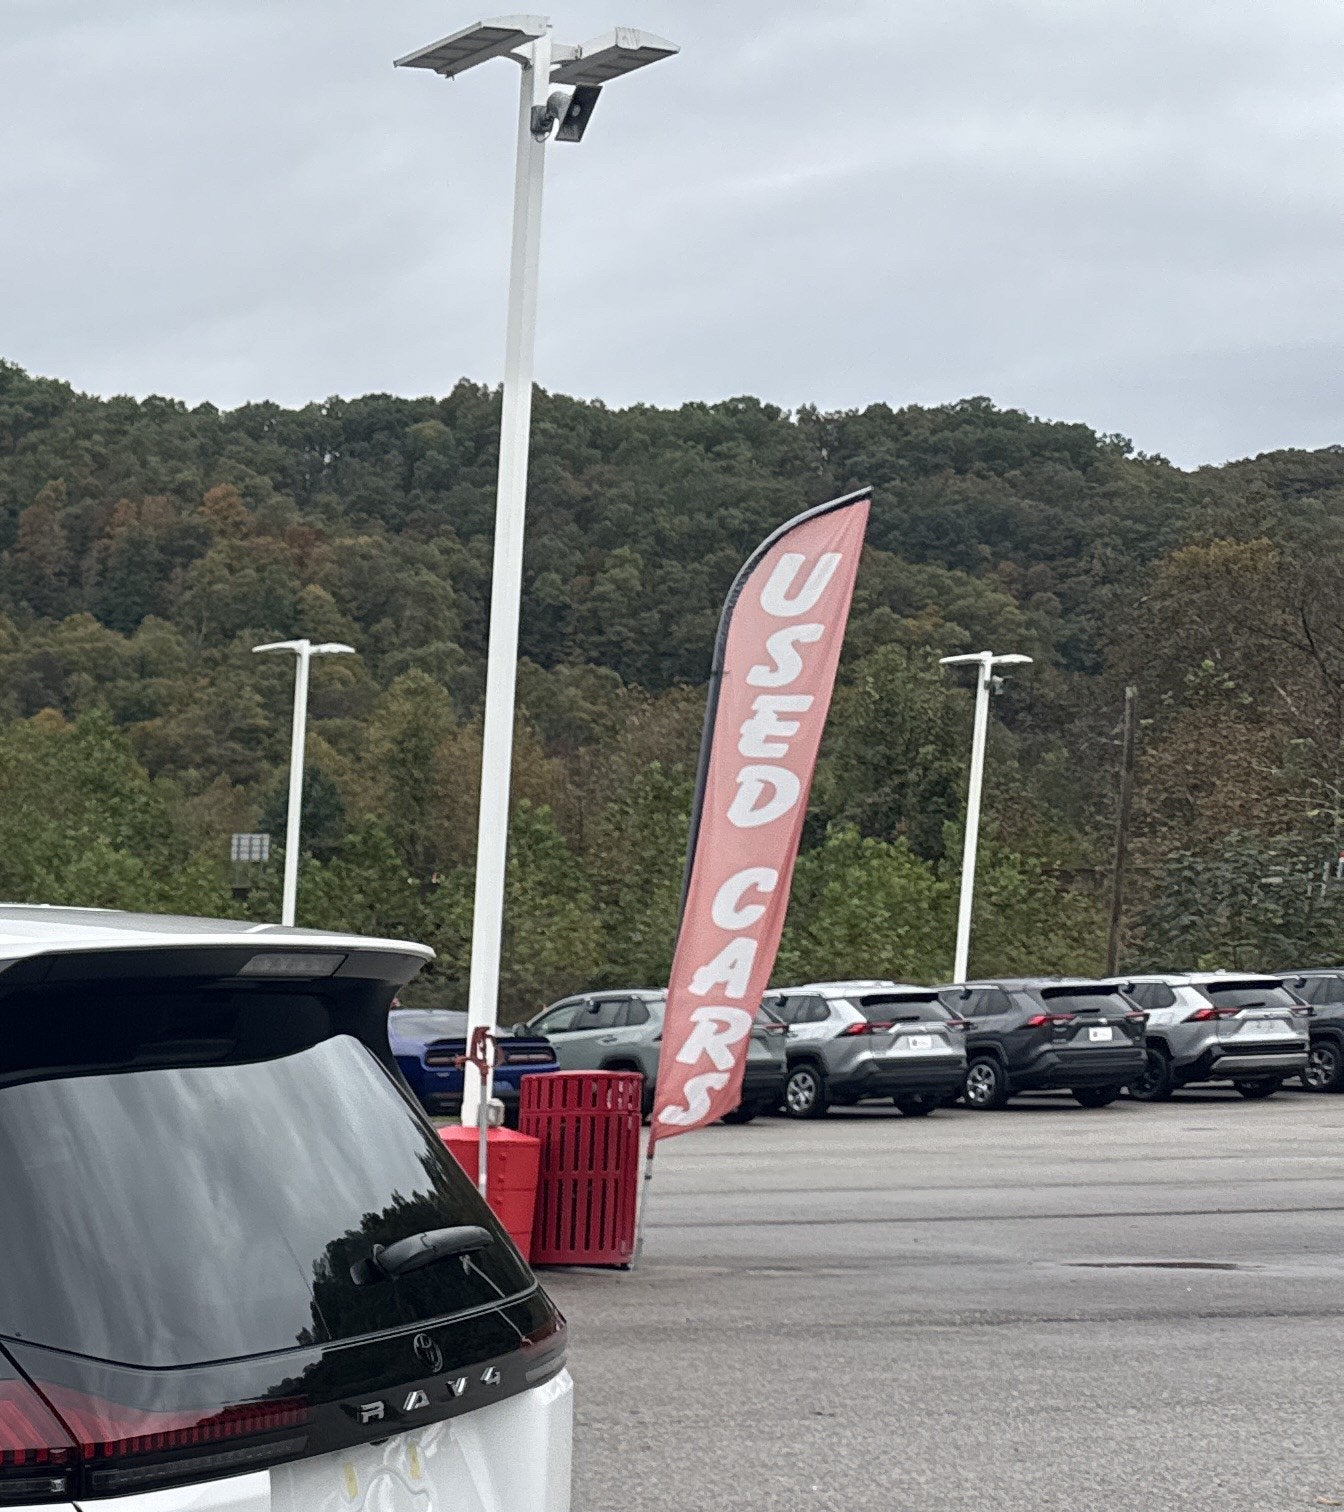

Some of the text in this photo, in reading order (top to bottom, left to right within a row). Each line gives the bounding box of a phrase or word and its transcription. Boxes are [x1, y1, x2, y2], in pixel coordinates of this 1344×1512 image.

[657, 551, 843, 1128] USED CARS
[357, 1366, 501, 1424] RAV4
